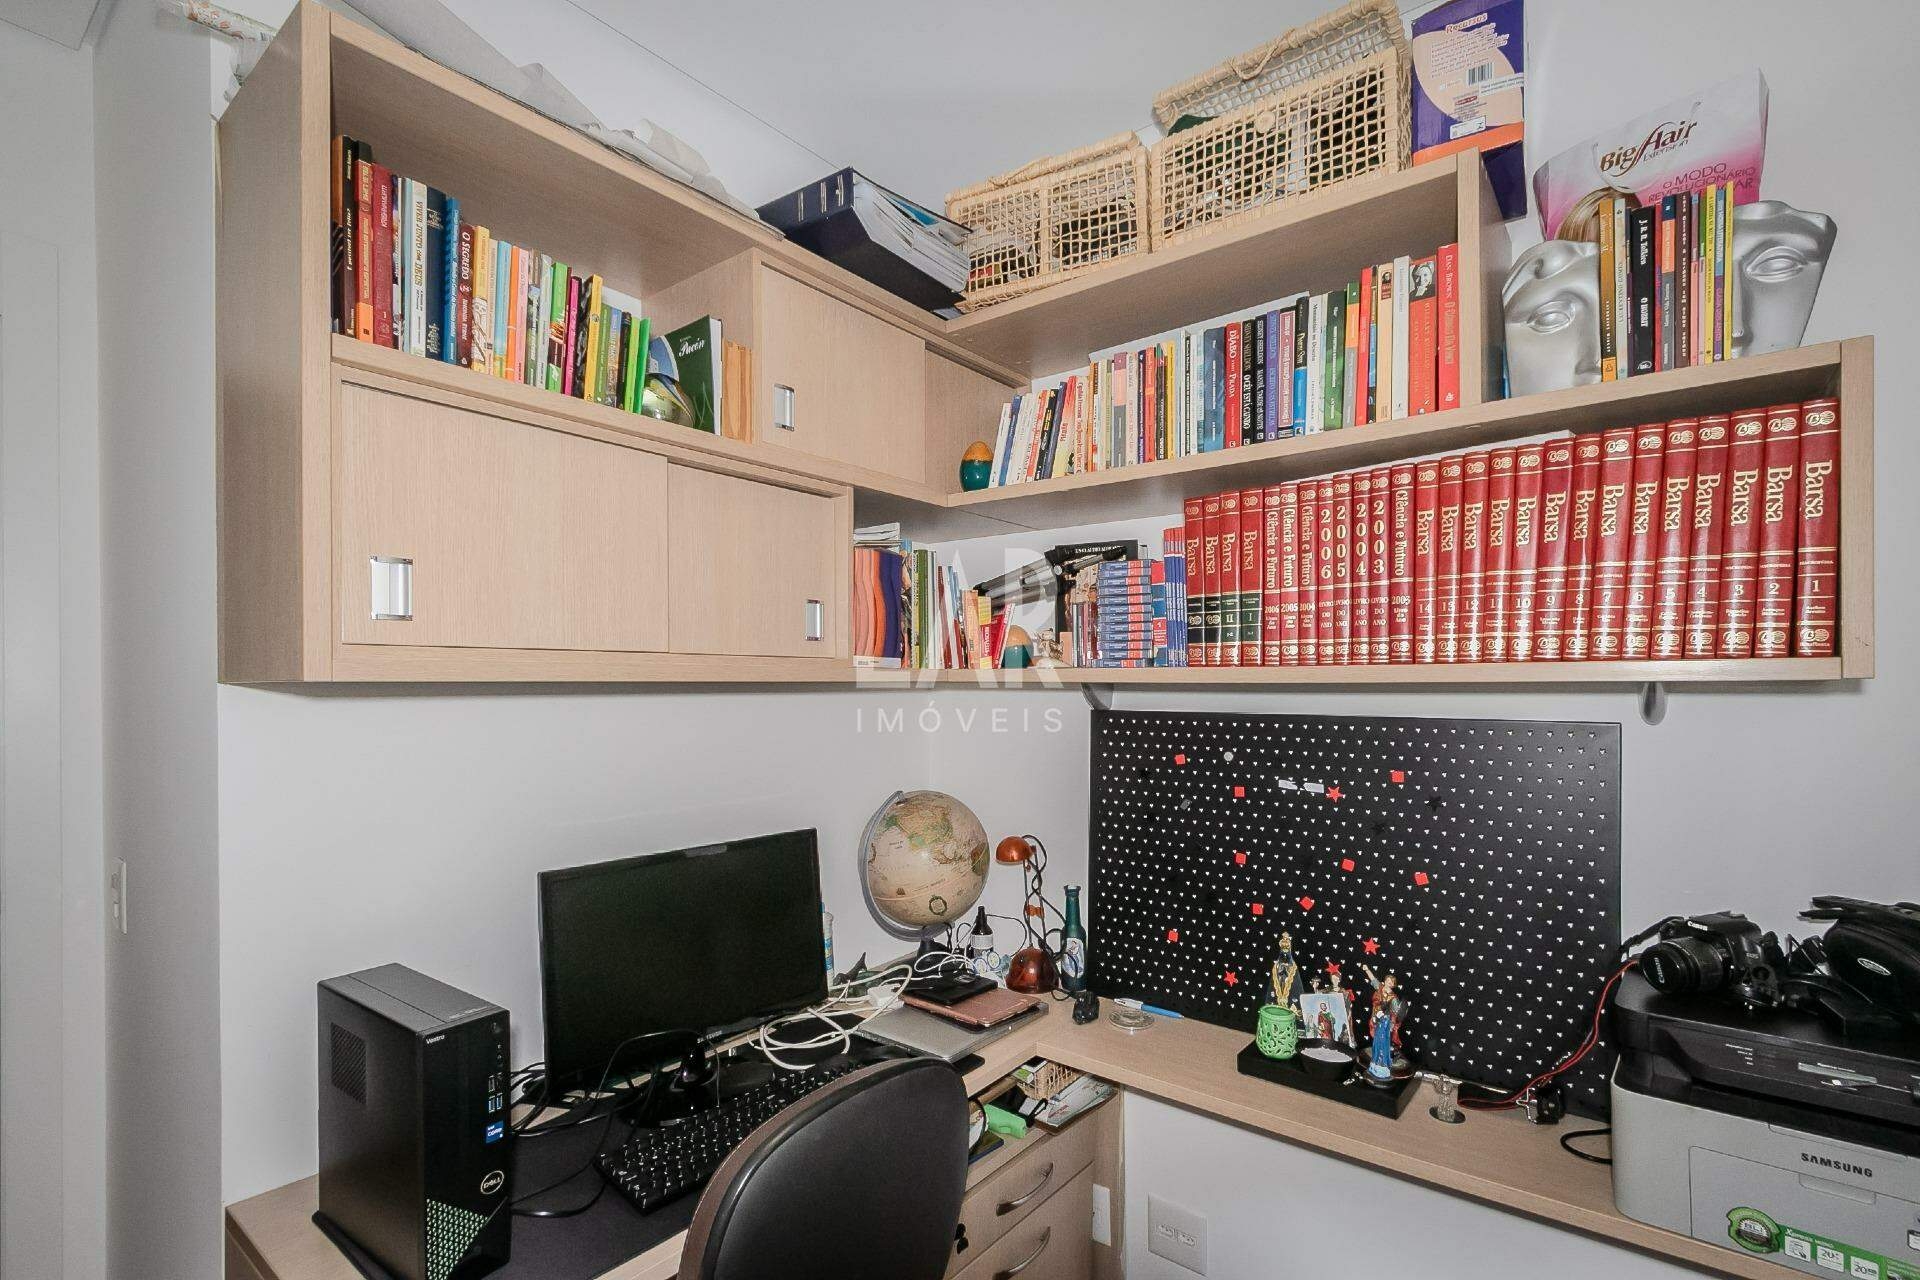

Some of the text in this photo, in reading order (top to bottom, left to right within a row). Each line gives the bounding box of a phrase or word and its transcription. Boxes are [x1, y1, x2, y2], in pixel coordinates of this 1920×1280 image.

[1445, 13, 1488, 33] Recursos
[1600, 146, 1640, 175] Big
[1675, 162, 1727, 186] MODO
[416, 201, 424, 222] VIVER
[416, 224, 424, 248] JUNTO
[462, 231, 471, 242] O
[462, 242, 471, 280] SEGREDO
[1445, 255, 1453, 271] DAN
[1640, 241, 1648, 266] Tolkien
[415, 263, 423, 286] DEUS
[1445, 272, 1453, 299] BROWN
[1640, 303, 1648, 328] HOBBIT
[1228, 330, 1238, 358] DIABO
[1228, 373, 1237, 398] PRADA
[1664, 476, 1690, 532] Barsa
[1695, 473, 1721, 530] Barsa
[1731, 469, 1759, 527] Barsa
[1765, 465, 1792, 524] Barsa
[1805, 460, 1832, 520] Barsa
[1395, 490, 1408, 529] Ciência
[1490, 497, 1510, 548] Barsa
[1516, 495, 1537, 547] Barsa
[1544, 491, 1566, 544] Barsa
[1574, 488, 1596, 541] Barsa
[1601, 483, 1625, 538] Barsa
[1633, 481, 1658, 536] Barsa
[1266, 511, 1279, 547] Ciência
[1282, 507, 1296, 544] Ciência
[1301, 505, 1314, 542] Ciência
[1417, 508, 1434, 556] Barsa
[1441, 505, 1460, 552] Barsa
[1464, 502, 1483, 550] Barsa
[1187, 538, 1200, 577] Barsa
[1205, 534, 1219, 575] Barsa
[1222, 530, 1236, 573] Barsa
[1243, 530, 1258, 571] Barsa
[1395, 539, 1408, 576] Futuro
[1266, 555, 1279, 590] Futuro
[1282, 554, 1296, 588] Futuro
[1301, 552, 1314, 585] Futuro
[1576, 593, 1584, 604] 8
[1603, 591, 1611, 602] 7
[1635, 591, 1644, 601] 6
[1666, 588, 1675, 599] 5
[1697, 586, 1707, 598] 4
[1734, 584, 1744, 596] 3
[1769, 582, 1780, 595] 2
[1812, 579, 1820, 592] 1
[1264, 605, 1279, 613] 2006
[1281, 603, 1298, 612] 2005
[1516, 596, 1531, 608] 10
[1547, 595, 1555, 605] 9
[1687, 920, 1708, 932] Canon
[1652, 957, 1665, 984] Canon
[1801, 1152, 1873, 1178] SAMSUNG
[483, 1177, 501, 1190] DELL
[1854, 1264, 1867, 1275] 20
